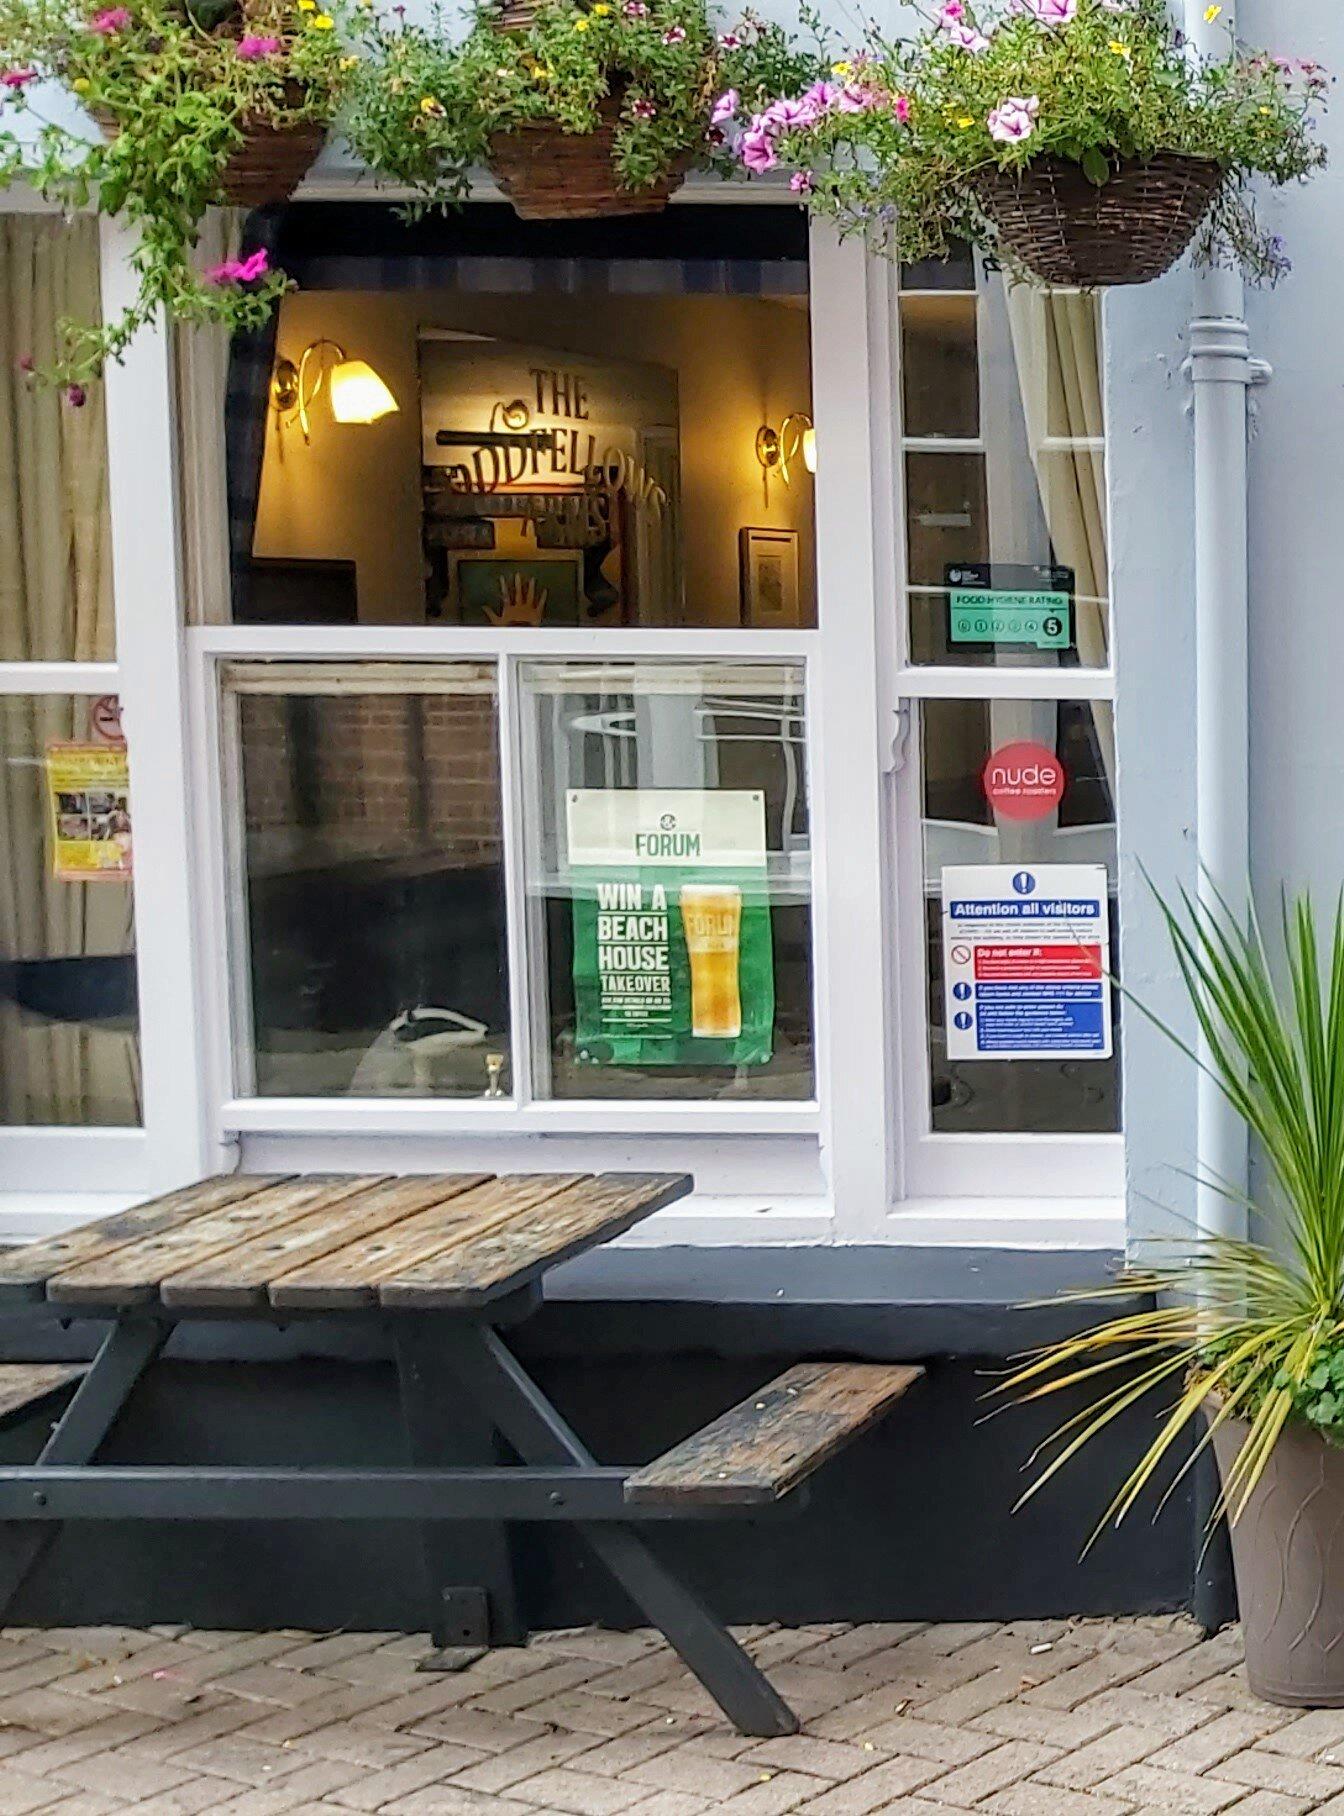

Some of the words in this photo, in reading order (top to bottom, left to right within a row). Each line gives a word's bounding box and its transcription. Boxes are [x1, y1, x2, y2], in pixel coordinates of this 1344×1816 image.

[530, 368, 589, 420] THE
[956, 595, 986, 605] FOOD
[1029, 596, 1063, 605] RATING
[1047, 619, 1059, 635] 5
[992, 763, 1056, 785] nude
[635, 833, 701, 856] FORUM
[597, 883, 642, 910] WIN
[652, 884, 667, 910] A
[955, 902, 1018, 916] Attention
[1022, 902, 1039, 916] all
[1042, 902, 1095, 916] visitors
[597, 916, 668, 941] BEACH
[598, 946, 669, 971] HOUSE
[600, 975, 671, 993] TAKEOVER
